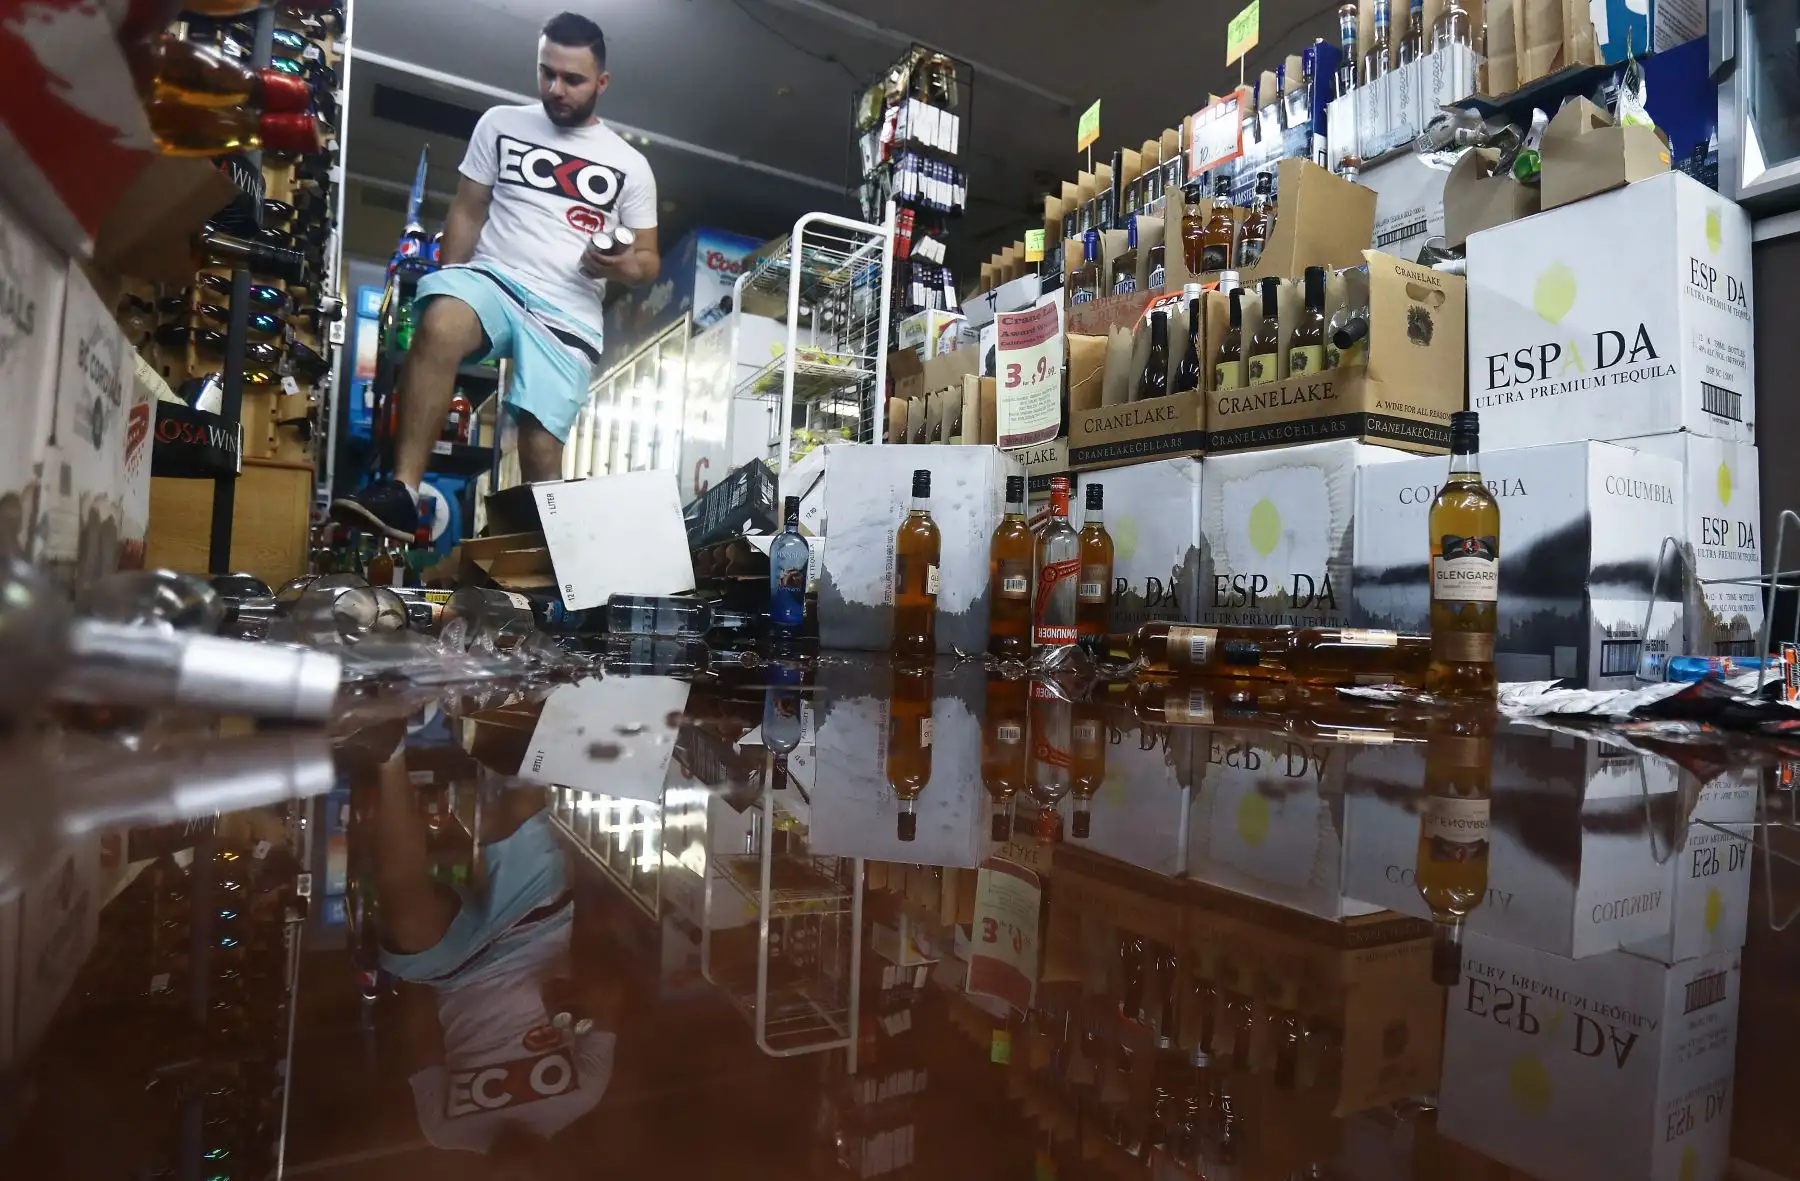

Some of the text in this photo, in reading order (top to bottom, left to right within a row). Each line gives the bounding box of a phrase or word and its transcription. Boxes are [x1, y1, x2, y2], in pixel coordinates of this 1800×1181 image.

[705, 250, 744, 273] Coo
[1005, 363, 1021, 388] 3
[1476, 364, 1677, 408] ULTRA PREMIUM TEQUILA
[1218, 382, 1336, 415] CRANELAKE
[1385, 401, 1403, 412] WINE
[1404, 404, 1416, 414] FOR
[1417, 407, 1428, 417] ALL
[1429, 409, 1451, 420] REASON
[1084, 405, 1177, 433] CRANELAKE
[1367, 418, 1451, 443] CRANELAKECELLA
[546, 492, 555, 507] LITER
[1605, 475, 1674, 505] COLUMBIA
[1436, 570, 1498, 581] GLENGARRY
[1242, 613, 1300, 626] PREMIUM
